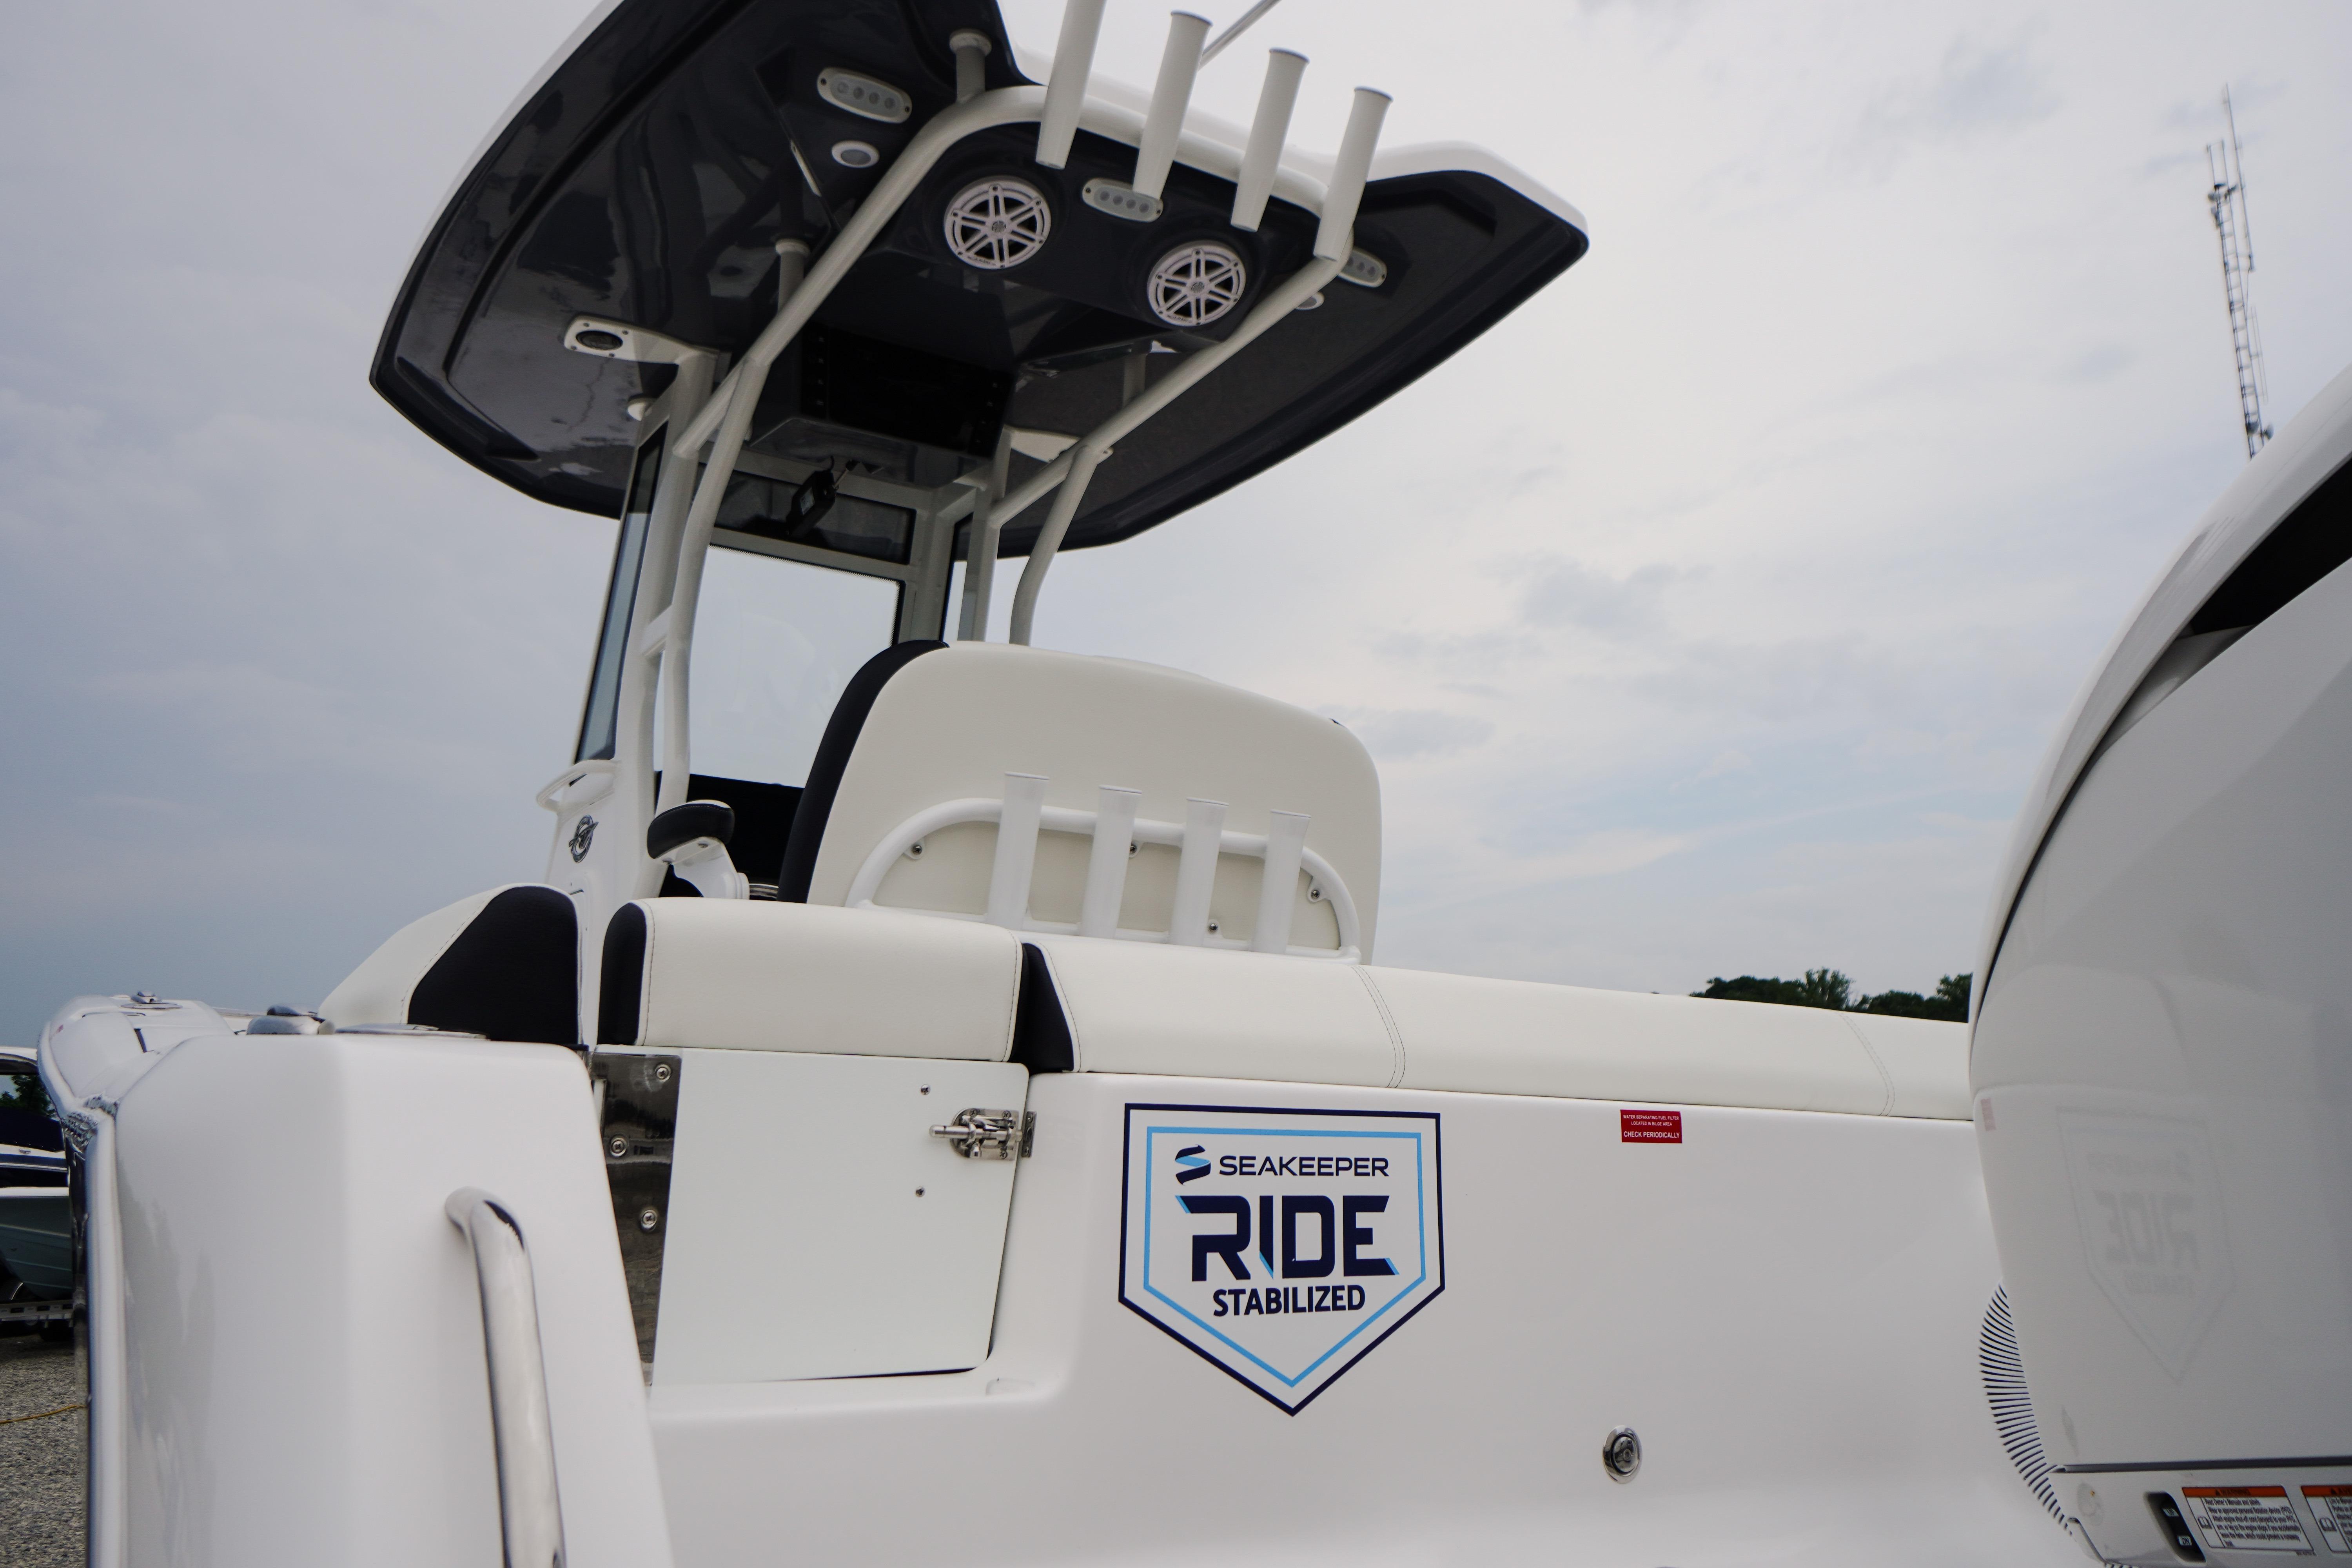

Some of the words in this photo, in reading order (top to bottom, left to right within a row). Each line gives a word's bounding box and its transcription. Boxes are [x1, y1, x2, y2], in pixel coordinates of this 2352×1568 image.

[1219, 1155, 1390, 1177] SEAKEEPER
[1175, 1195, 1400, 1282] RIDE
[1213, 1284, 1366, 1317] STABILIZED
